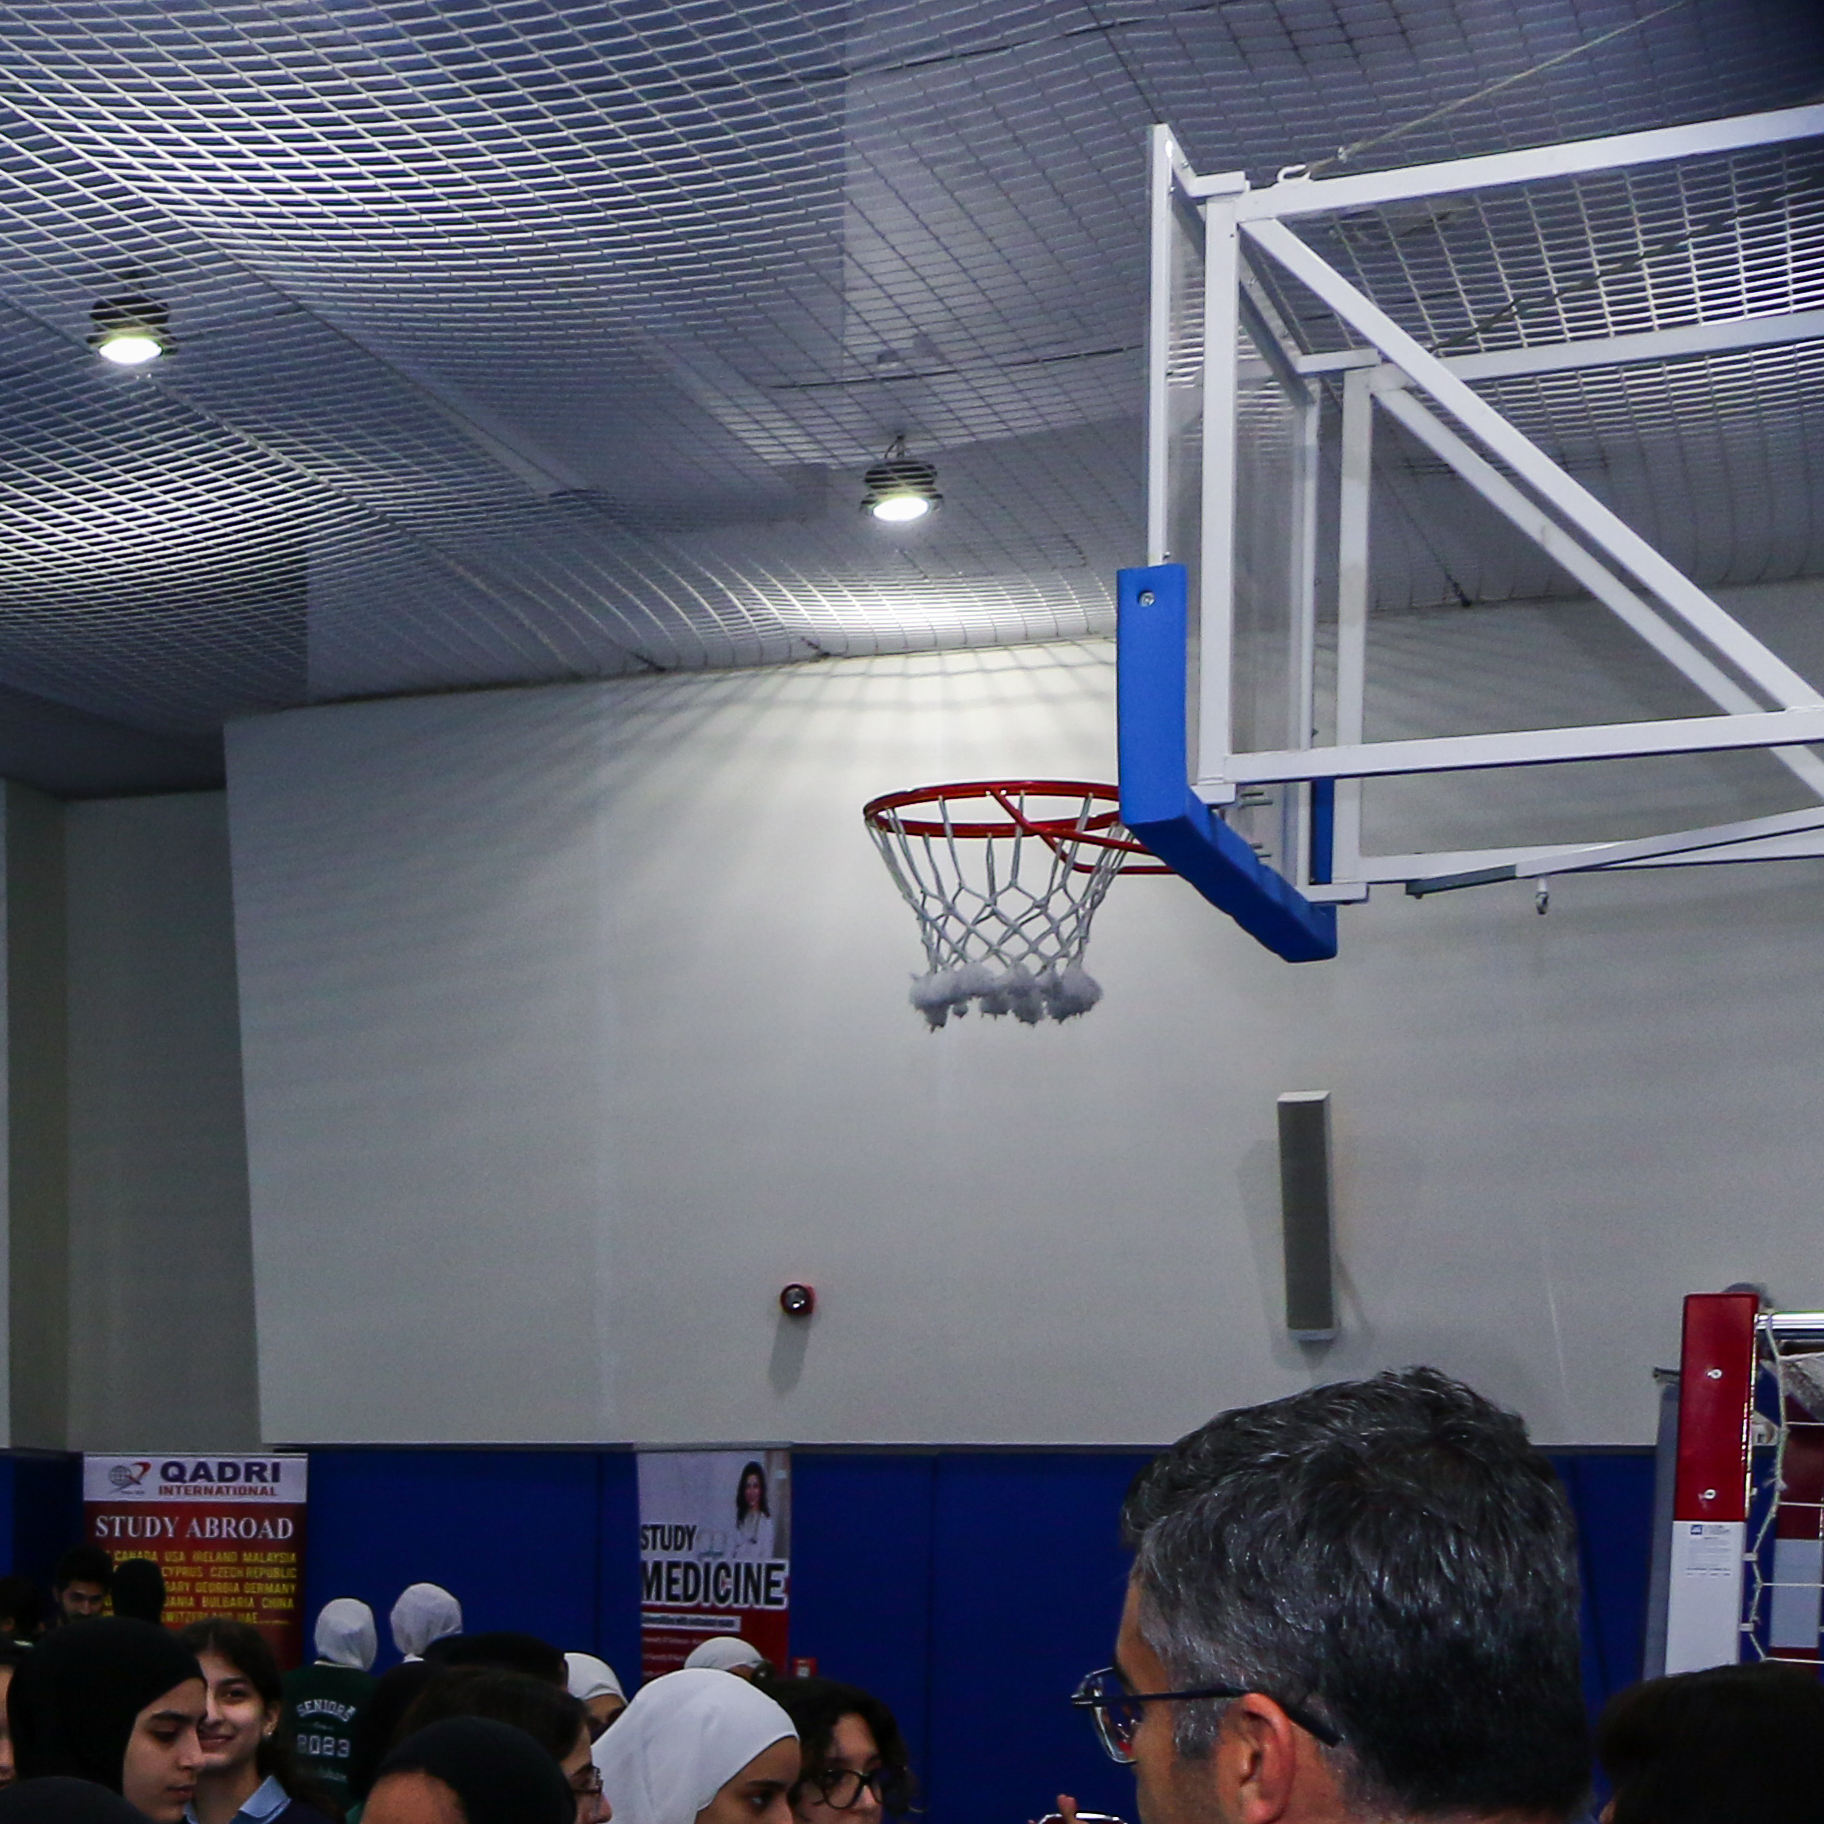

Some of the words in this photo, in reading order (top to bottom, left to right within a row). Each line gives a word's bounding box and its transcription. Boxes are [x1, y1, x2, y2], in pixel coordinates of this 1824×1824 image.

[160, 1461, 281, 1483] QADRI
[158, 1485, 278, 1496] INTERNATIONAL
[94, 1515, 180, 1538] STUDY
[185, 1517, 295, 1539] ABROAD
[641, 1523, 697, 1551] STUDY
[164, 1551, 186, 1562] USA
[193, 1551, 238, 1562] IRELAND
[243, 1552, 297, 1563] MALAYSIA
[246, 1567, 298, 1578] REPUBLIC
[195, 1582, 240, 1594] GEORGIA
[244, 1582, 297, 1594] GERMANY
[641, 1560, 786, 1606] MEDICINE
[262, 1597, 295, 1609] CHINA
[295, 1698, 358, 1723] SENIORS
